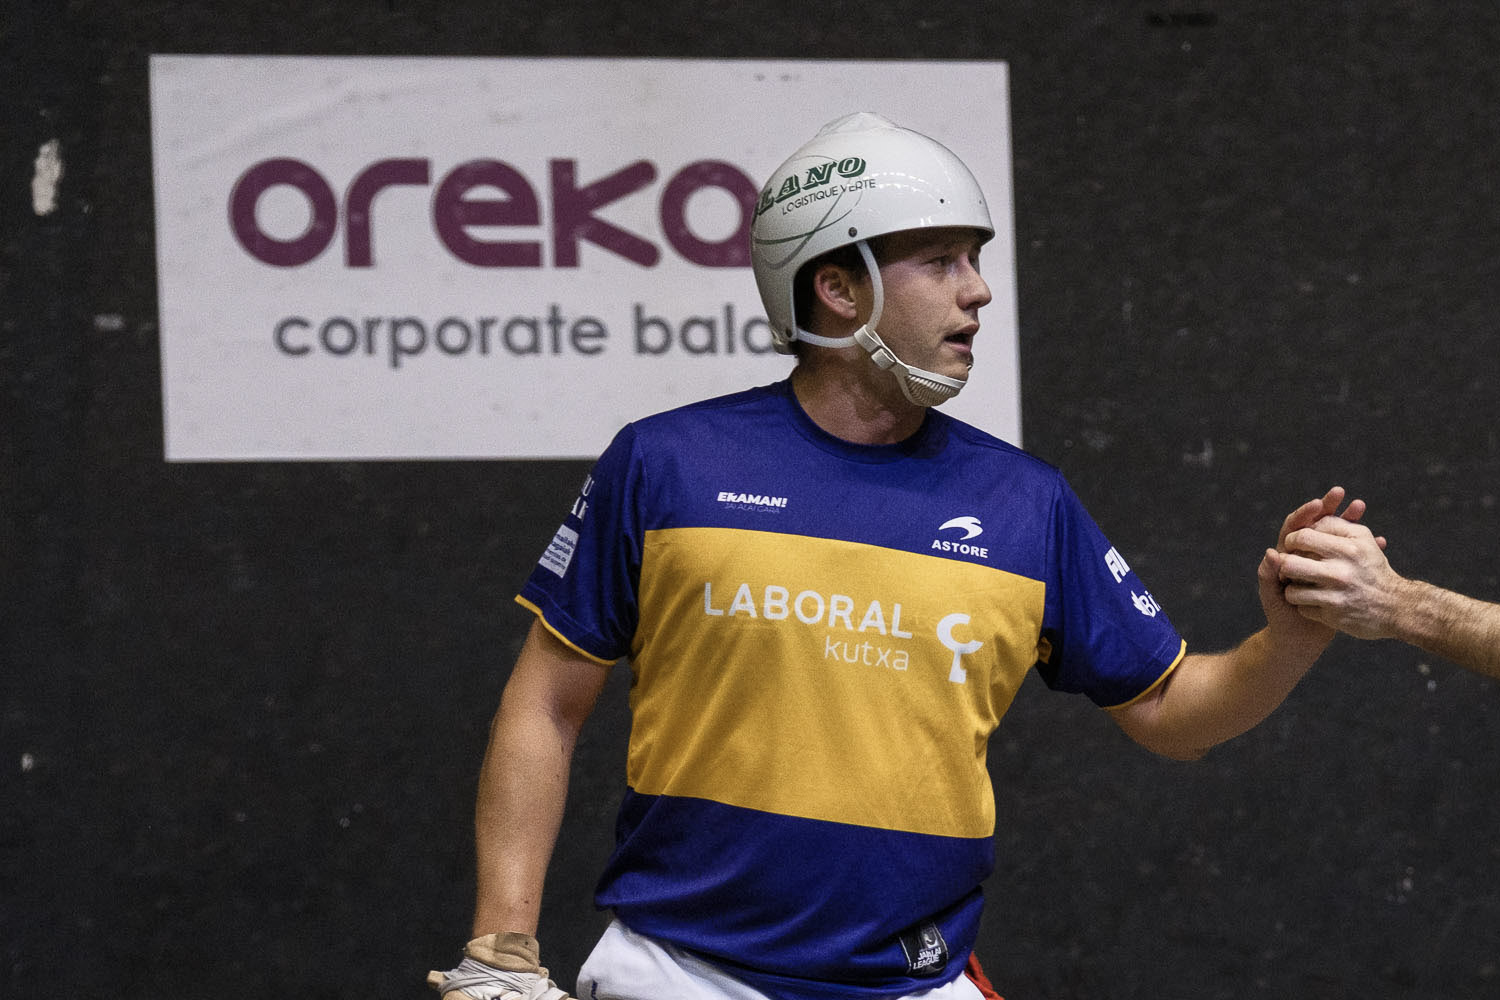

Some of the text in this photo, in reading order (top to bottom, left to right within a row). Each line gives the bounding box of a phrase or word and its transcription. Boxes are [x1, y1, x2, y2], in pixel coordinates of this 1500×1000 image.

[755, 157, 866, 218] LANO
[781, 179, 876, 216] LOGISTIQUE VERTE
[273, 303, 782, 369] corporate bala
[931, 539, 989, 558] ASTORE
[704, 582, 913, 639] LABORAL
[824, 636, 910, 672] kutxa
